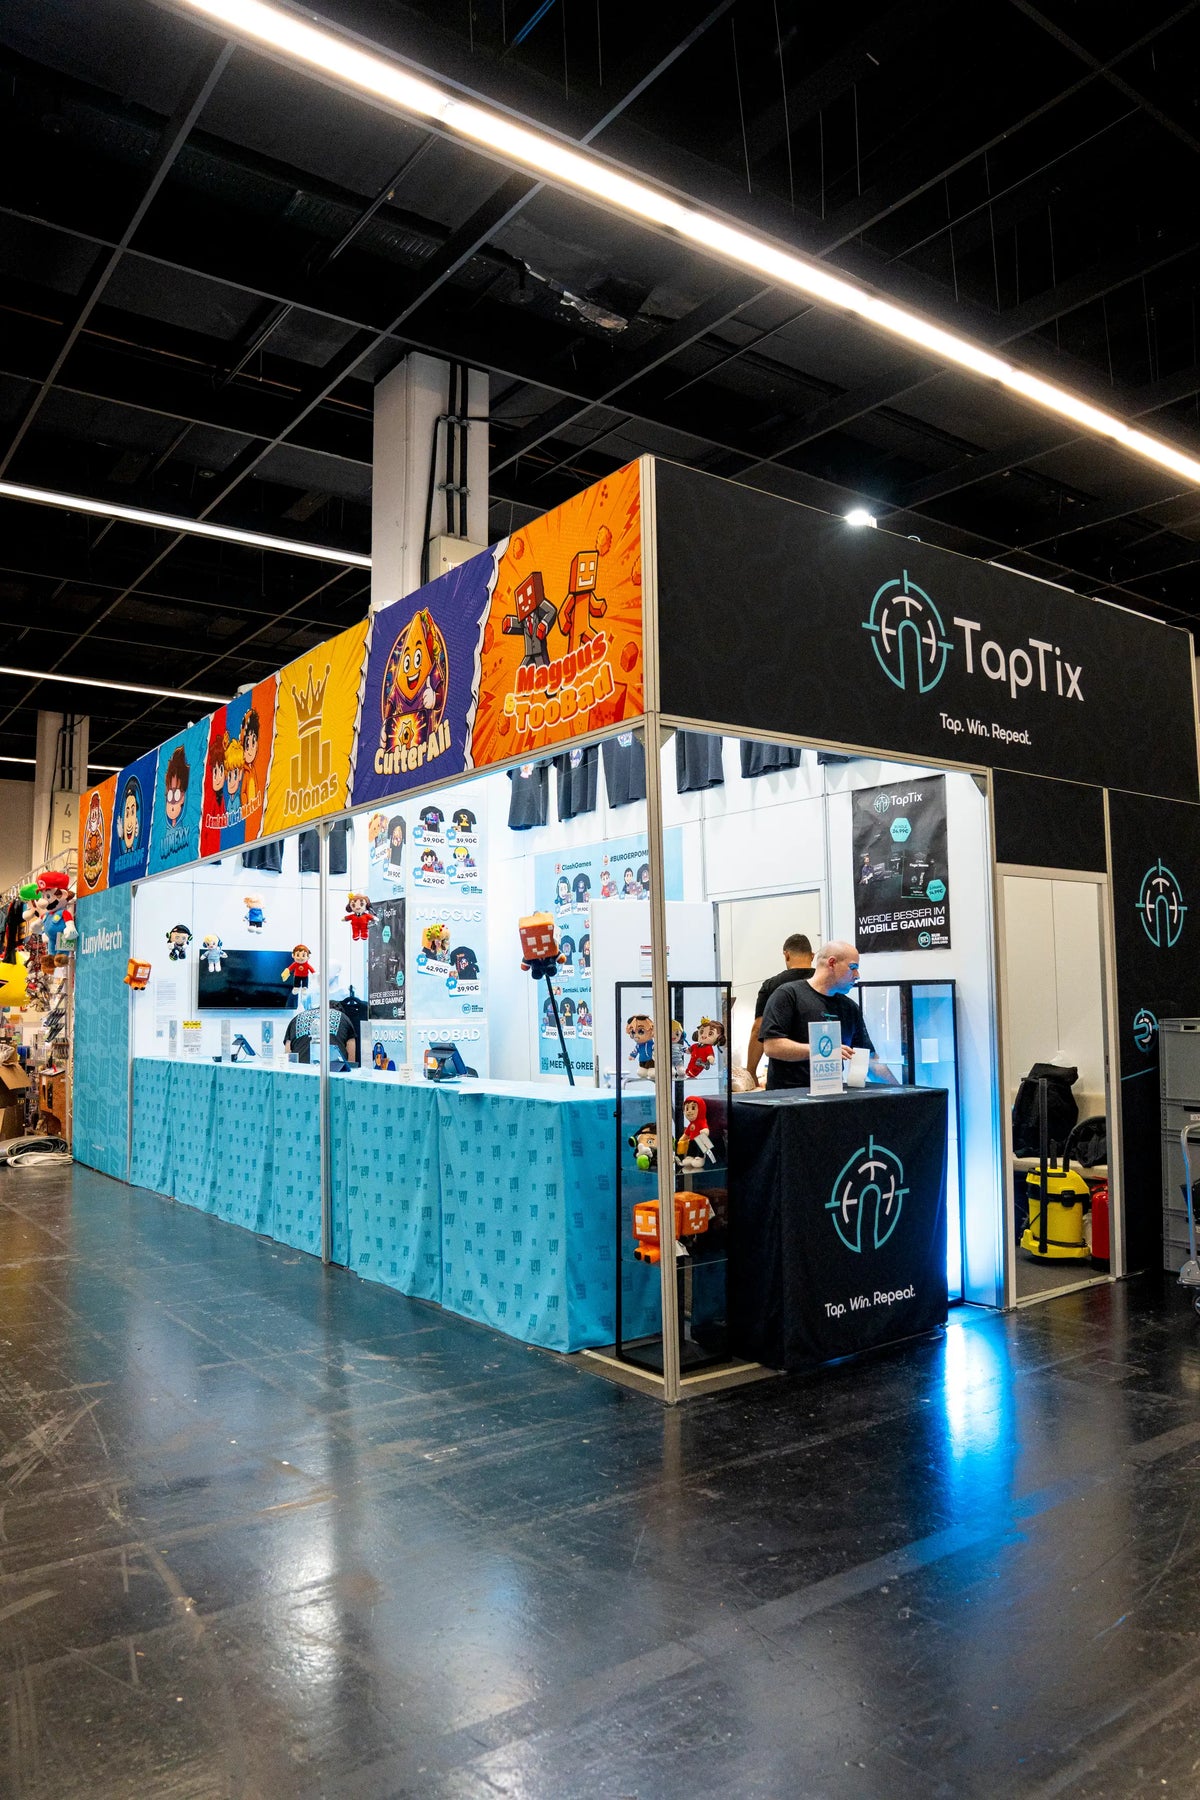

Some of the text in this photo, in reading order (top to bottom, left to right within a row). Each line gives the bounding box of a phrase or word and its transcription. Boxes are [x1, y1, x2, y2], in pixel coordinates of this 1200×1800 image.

[515, 631, 608, 697] Maggus
[953, 616, 1085, 702] TapTix
[514, 661, 615, 733] TooBad
[939, 712, 1032, 746] Tap. Win. Repeat.
[891, 791, 923, 807] TapTix
[64, 803, 72, 818] 4
[61, 829, 72, 844] B
[415, 907, 482, 922] MAGGUS
[859, 905, 945, 925] WERDE BESSER IM
[859, 916, 945, 935] MOBILE GAMING
[81, 923, 123, 958] LunyMerch
[417, 1029, 481, 1043] TOOBAD
[812, 1062, 840, 1073] KASSE
[824, 1284, 916, 1319] Tap. Win. Repeat.
